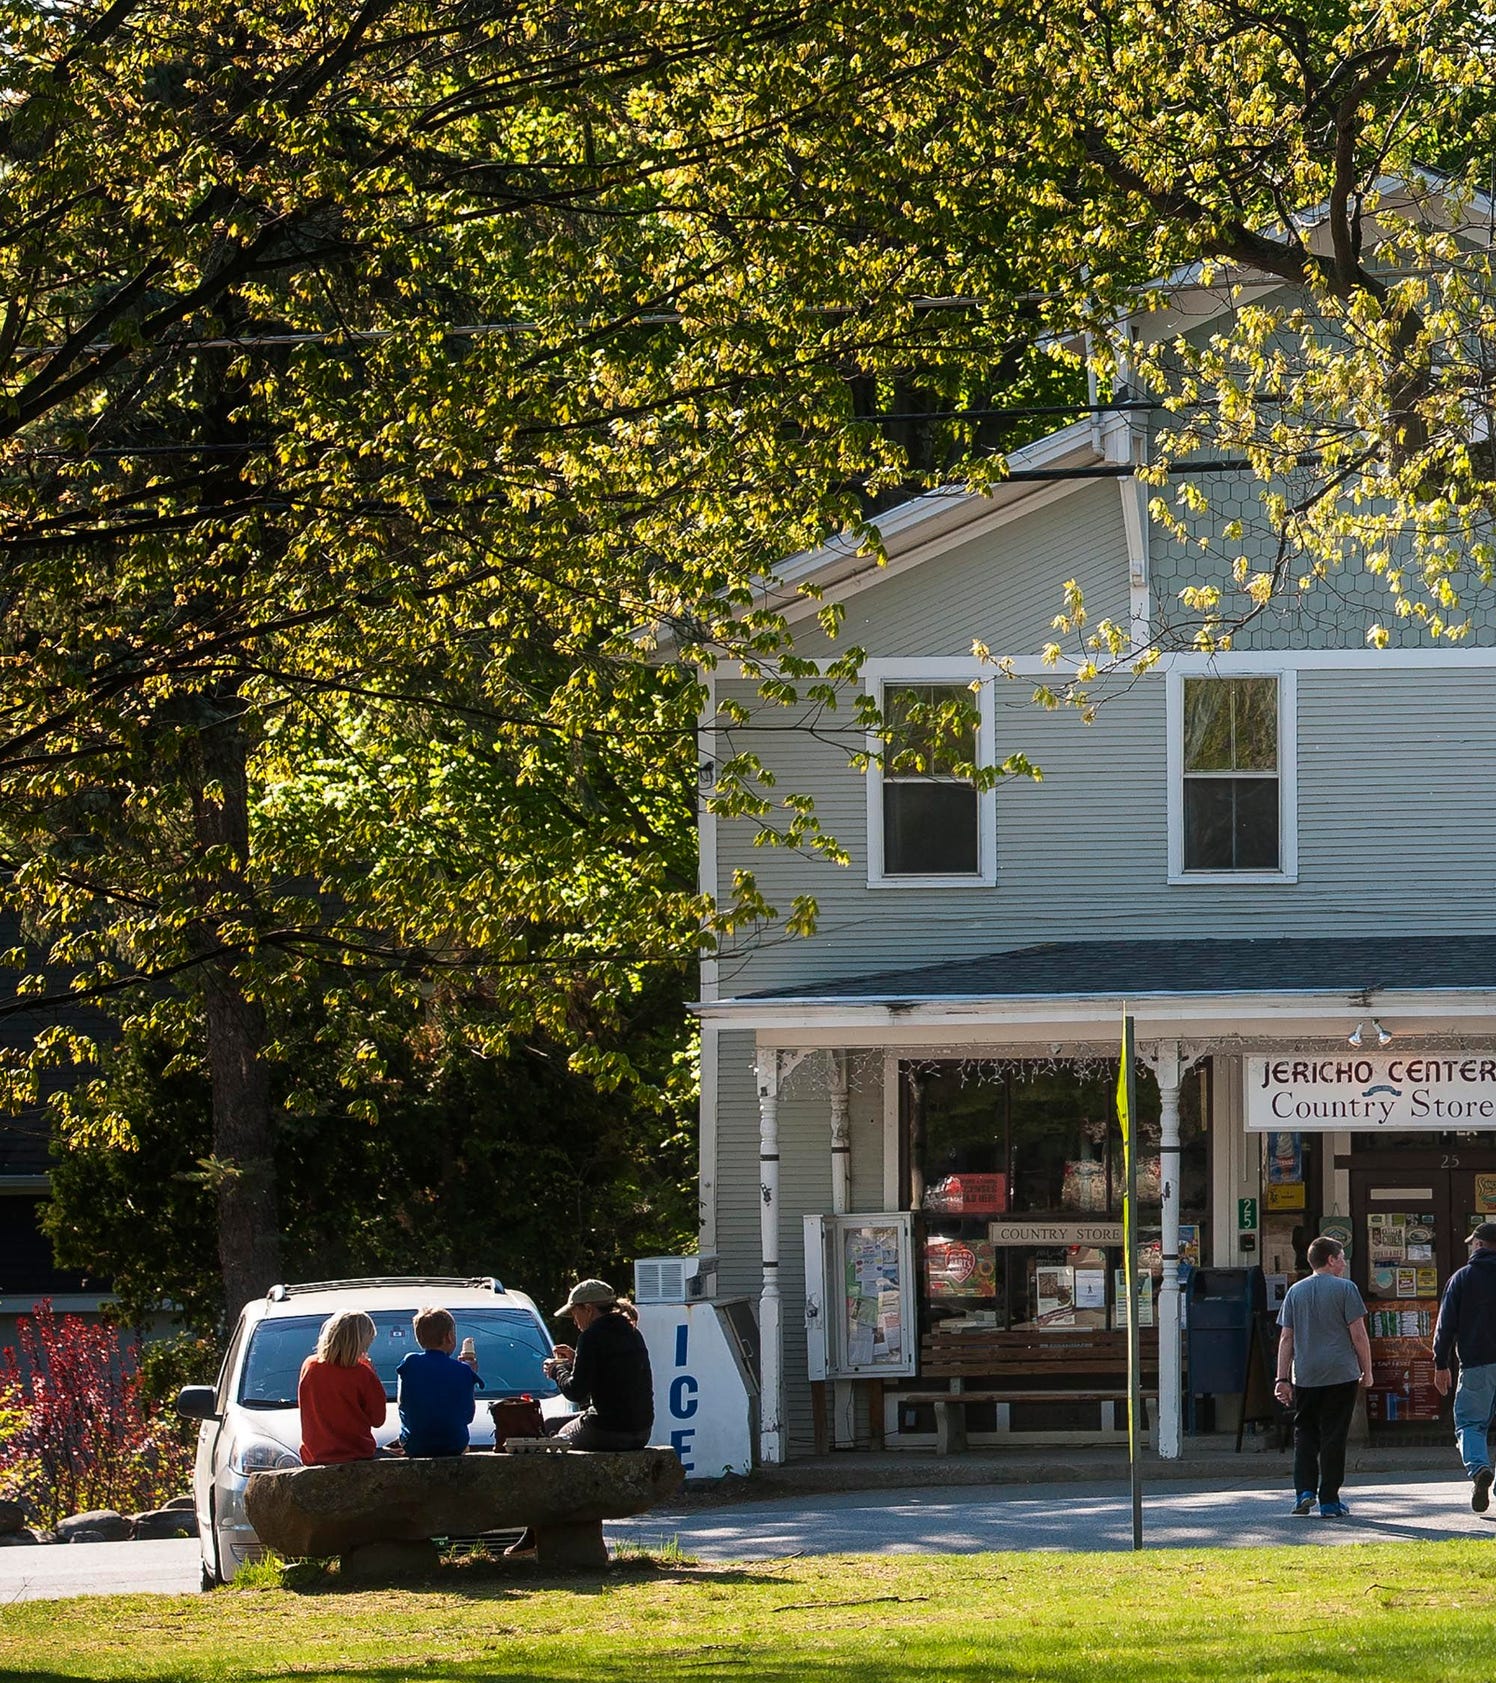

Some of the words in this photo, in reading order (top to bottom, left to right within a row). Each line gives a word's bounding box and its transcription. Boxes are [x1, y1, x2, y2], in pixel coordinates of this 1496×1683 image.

[1261, 1060, 1373, 1088] JERICHO
[1271, 1091, 1396, 1124] Country
[1411, 1089, 1494, 1118] Store
[1440, 1154, 1460, 1169] 25
[1000, 1228, 1068, 1240] COUNTRY
[1076, 1228, 1121, 1240] STORE
[669, 1325, 698, 1471] ICE
